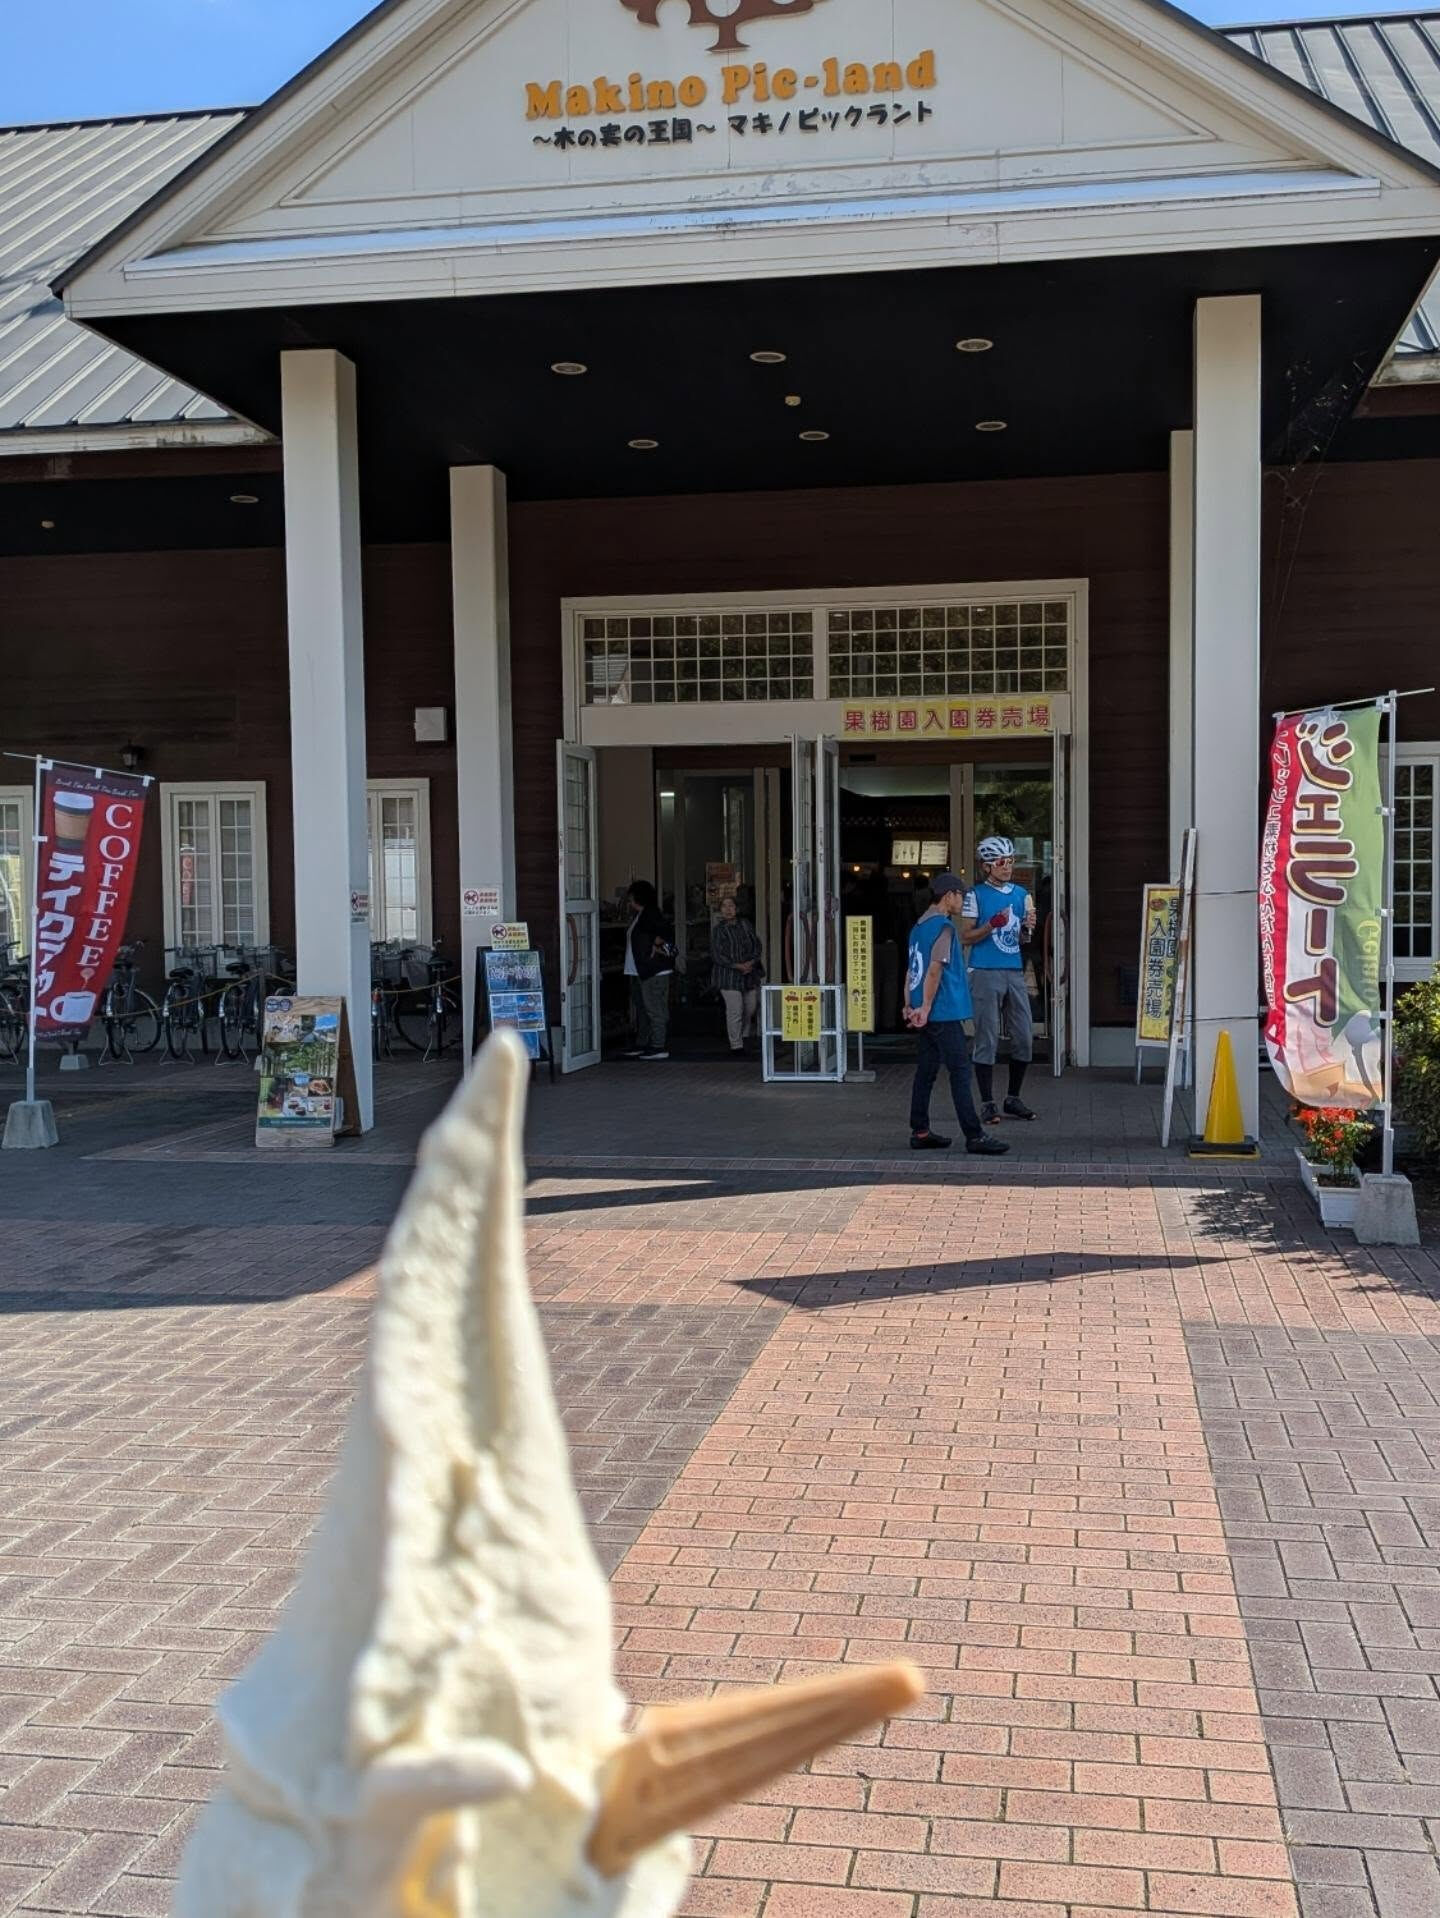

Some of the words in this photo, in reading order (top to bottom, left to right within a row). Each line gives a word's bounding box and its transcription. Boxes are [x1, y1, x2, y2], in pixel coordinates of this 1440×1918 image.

[525, 74, 708, 119] Makino
[721, 50, 937, 104] Pic-land
[844, 703, 1049, 732] 果樹園入園券売場
[76, 803, 133, 967] COFFEE
[1144, 917, 1167, 1019] 入園券売場
